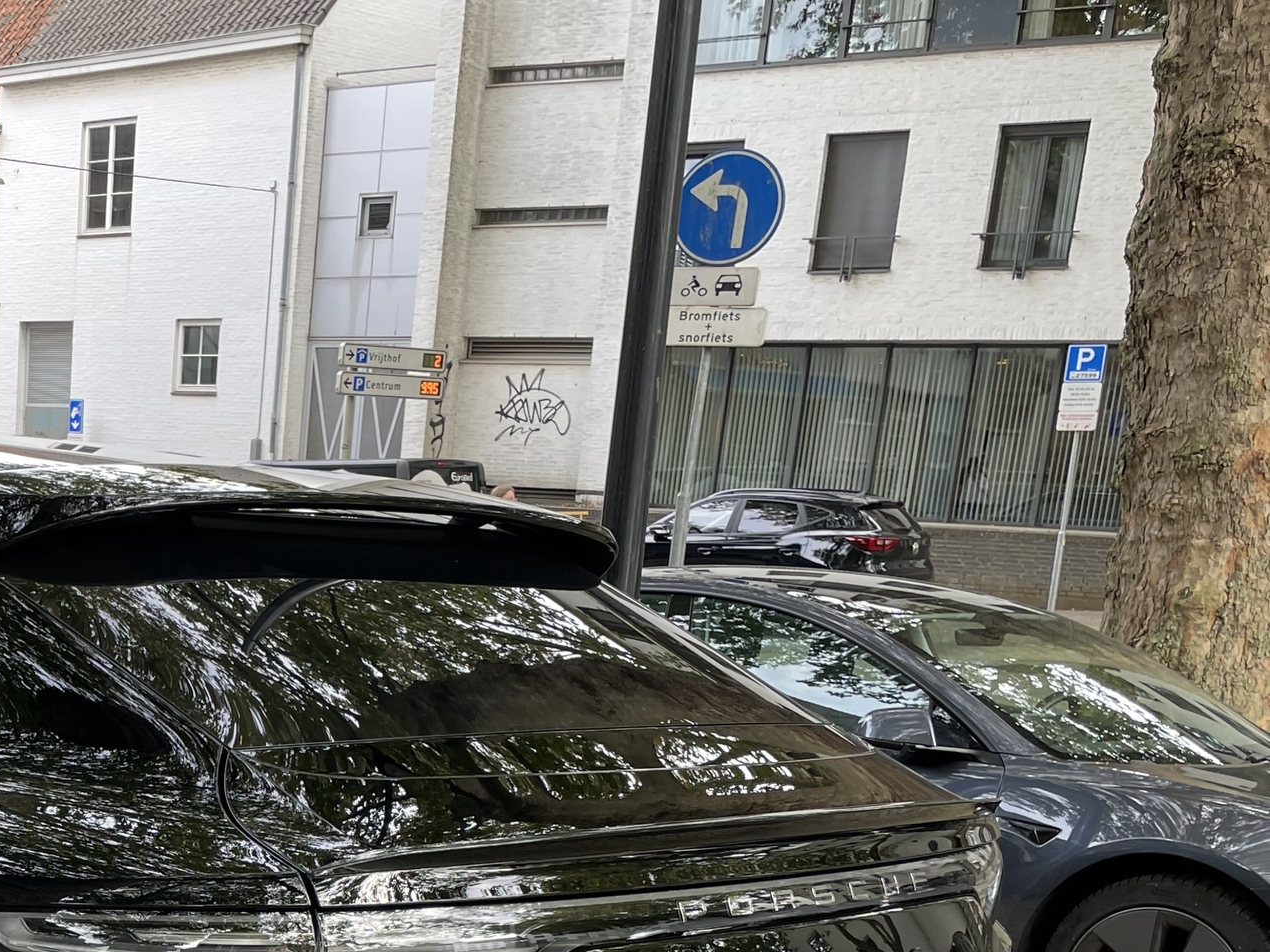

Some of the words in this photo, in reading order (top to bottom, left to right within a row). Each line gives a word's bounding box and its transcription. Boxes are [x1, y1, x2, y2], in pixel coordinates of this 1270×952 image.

[679, 310, 741, 321] Bromfiets
[679, 333, 734, 343] snorfiets
[369, 352, 402, 364] Vrijthof
[434, 355, 442, 368] 2
[366, 380, 402, 391] Centrum
[678, 872, 928, 923] PORSCHE
